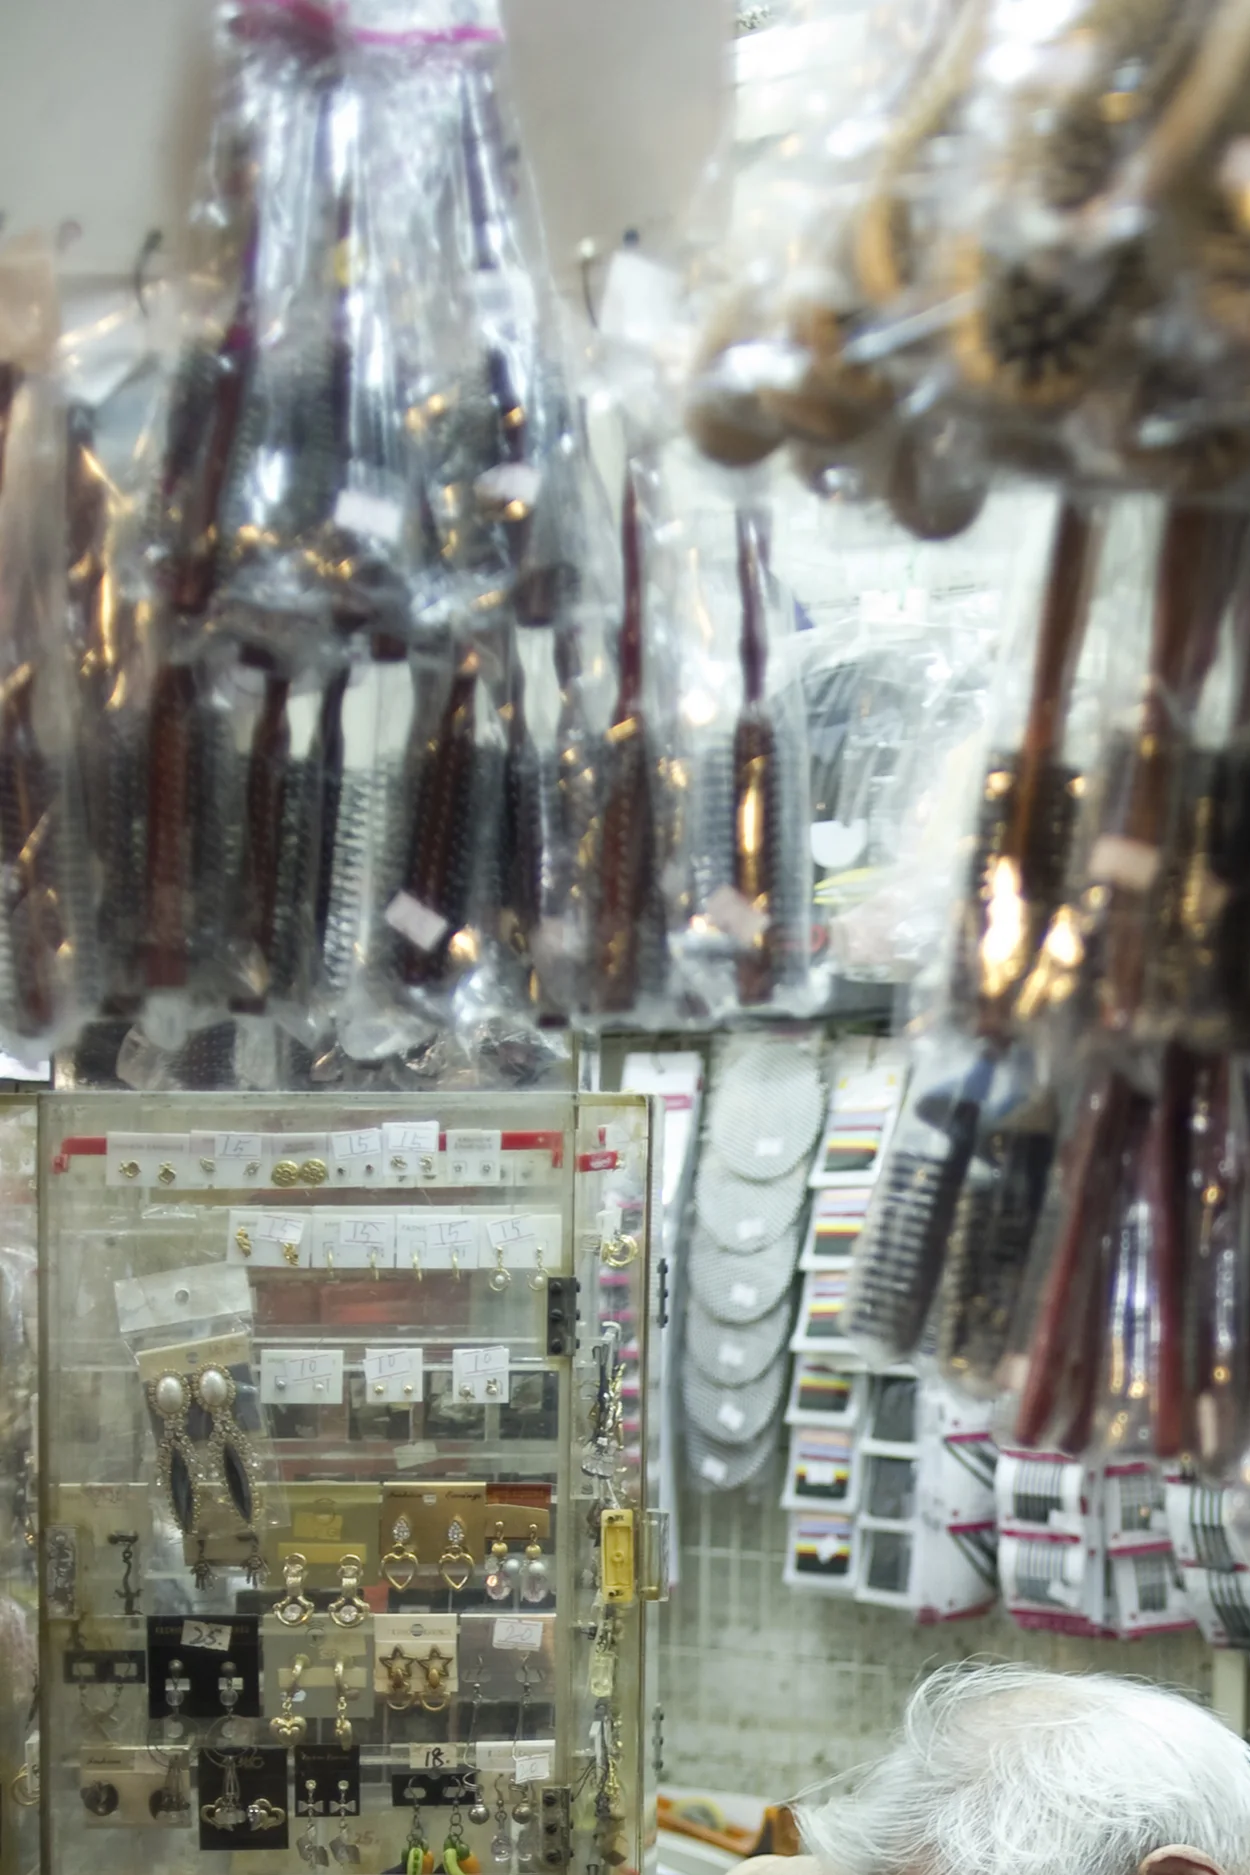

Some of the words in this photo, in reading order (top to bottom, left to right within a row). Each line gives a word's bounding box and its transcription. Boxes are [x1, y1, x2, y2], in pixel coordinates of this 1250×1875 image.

[223, 1135, 252, 1152] 15
[349, 1135, 371, 1154] 15
[401, 1130, 427, 1148] 15
[352, 1222, 379, 1242] 15
[501, 1220, 522, 1239] 15
[506, 1624, 533, 1643] 20
[425, 1747, 450, 1768] 18.
